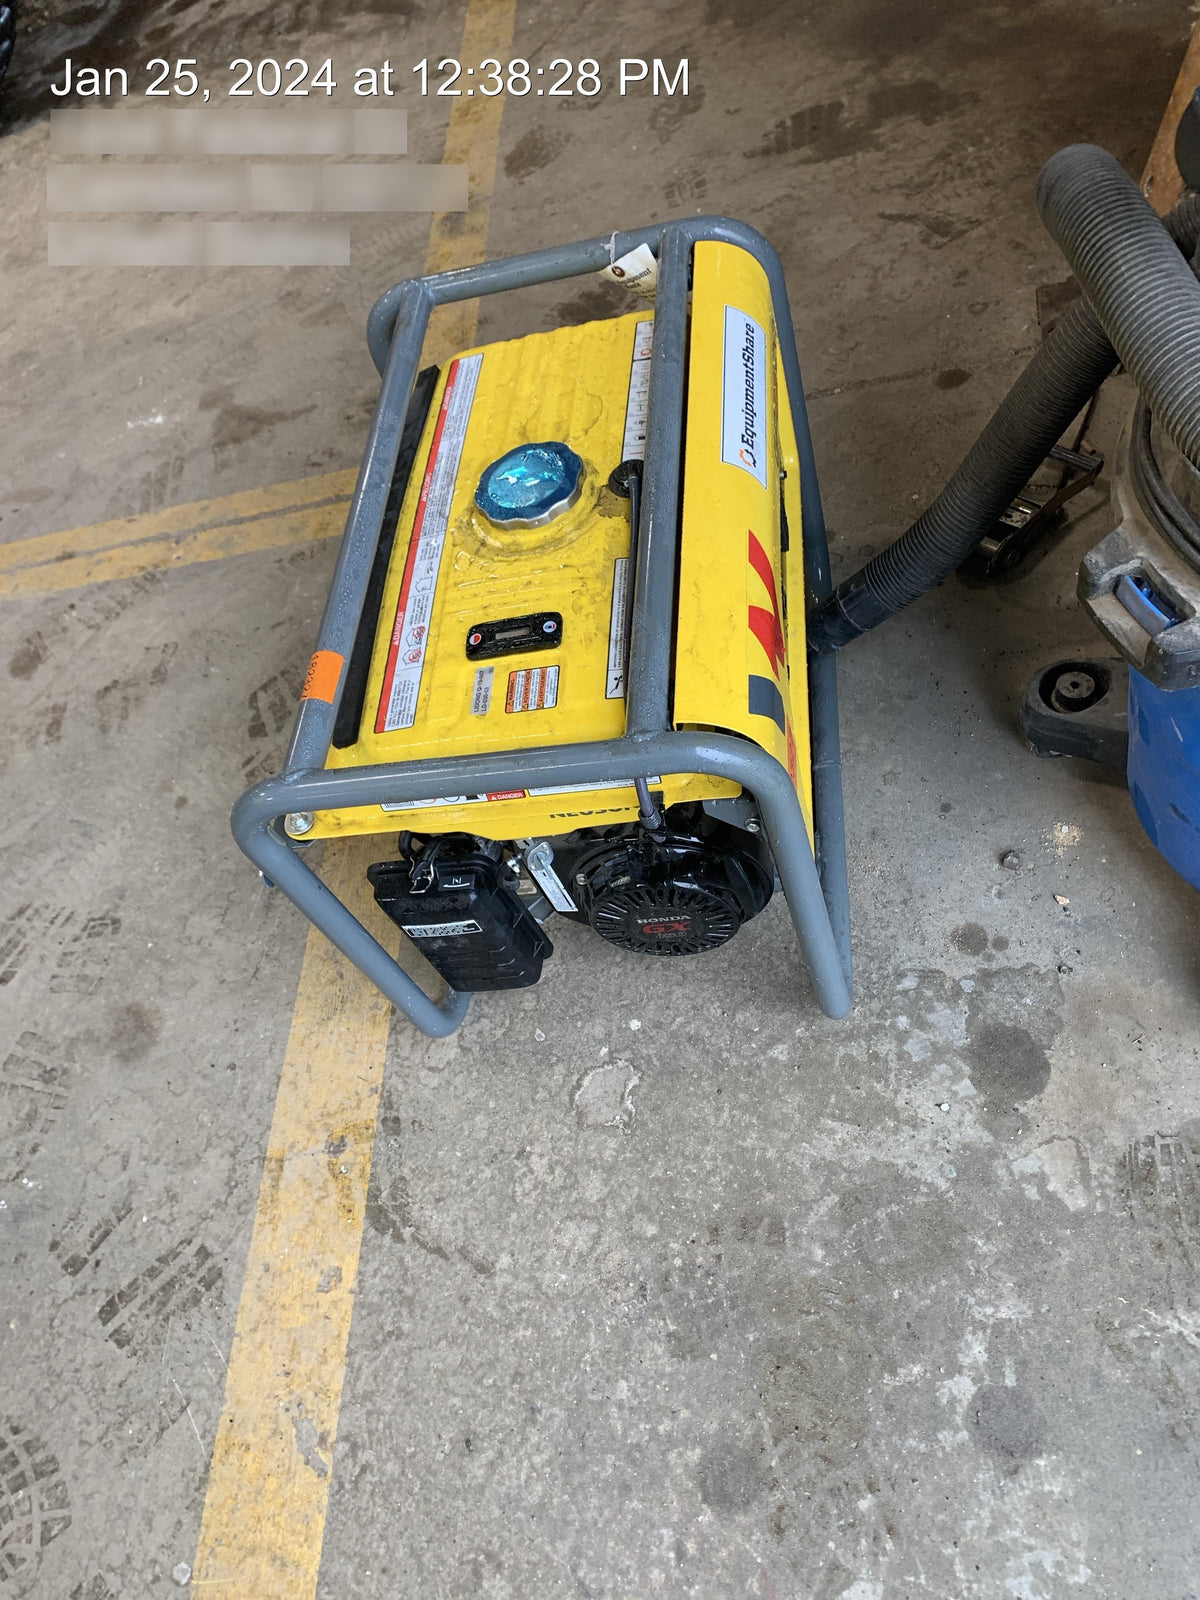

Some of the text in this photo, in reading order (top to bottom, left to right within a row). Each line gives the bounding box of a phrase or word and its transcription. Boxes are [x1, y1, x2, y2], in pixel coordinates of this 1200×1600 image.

[740, 323, 756, 450] EquipmentShare
[497, 791, 524, 800] DANGER
[636, 914, 692, 925] HONDA
[642, 921, 693, 934] GX
